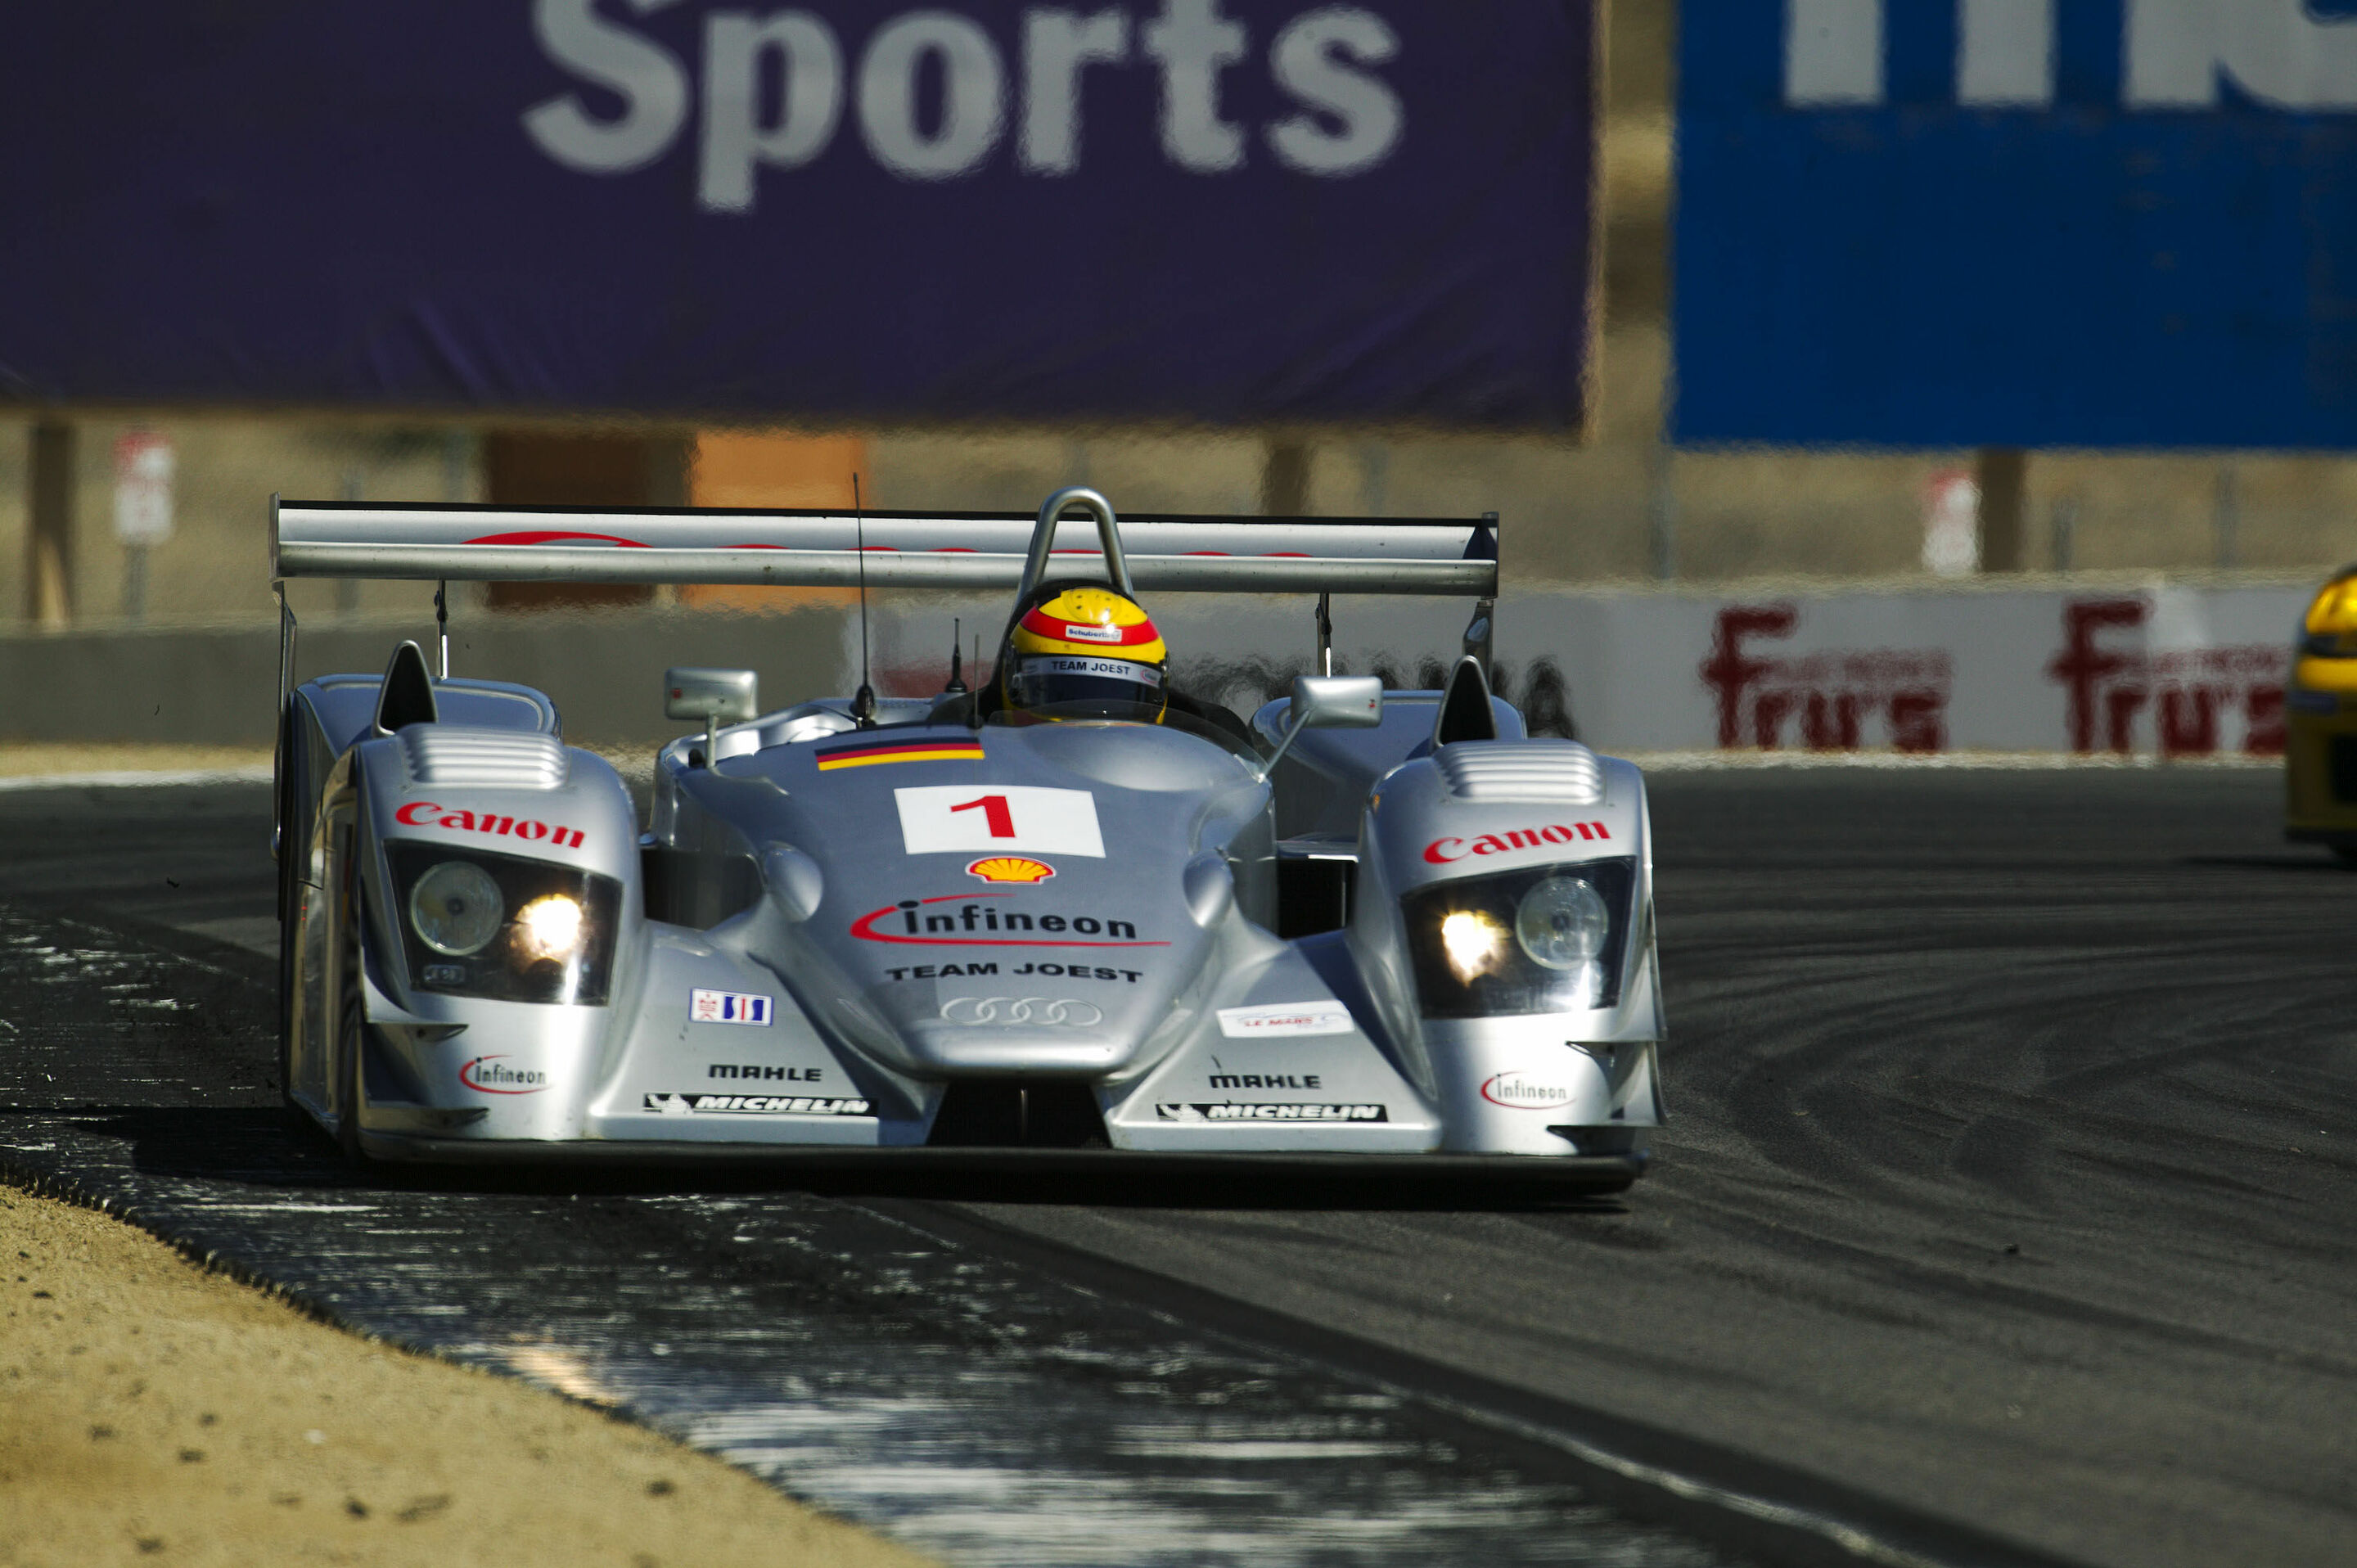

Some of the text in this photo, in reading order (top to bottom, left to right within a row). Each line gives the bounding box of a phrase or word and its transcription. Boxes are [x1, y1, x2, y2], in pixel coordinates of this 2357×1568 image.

[522, 0, 1404, 211] Sports
[1052, 660, 1088, 671] TEAM
[1091, 662, 1130, 675] JOEST
[394, 801, 586, 849] Canon
[950, 795, 1016, 839] 1
[1422, 821, 1611, 865] Canon
[884, 962, 1143, 983] TEAM JOEST
[709, 1064, 822, 1082] MAHLE
[1209, 1074, 1321, 1089] MAHLE
[695, 1095, 870, 1115] MICHELIN
[1206, 1104, 1381, 1120] MICHELIN
